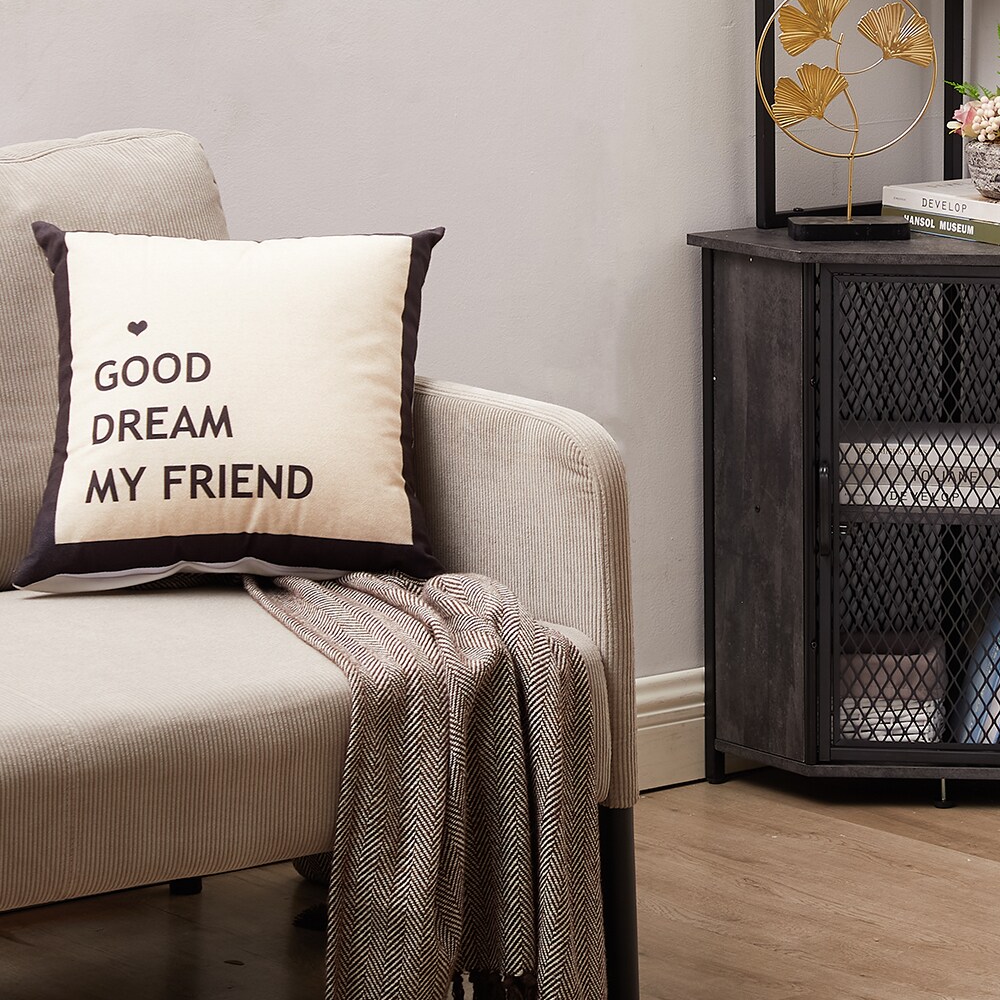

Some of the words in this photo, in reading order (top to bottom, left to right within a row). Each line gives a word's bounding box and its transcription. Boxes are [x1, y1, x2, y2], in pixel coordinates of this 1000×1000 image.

[921, 197, 968, 213] DEVELOP
[939, 220, 974, 236] MUSEUM
[94, 352, 212, 392] GOOD
[92, 405, 233, 445] DREAM
[85, 466, 147, 504] MY
[163, 463, 314, 500] FRIEND
[889, 491, 960, 502] DEVELOP
